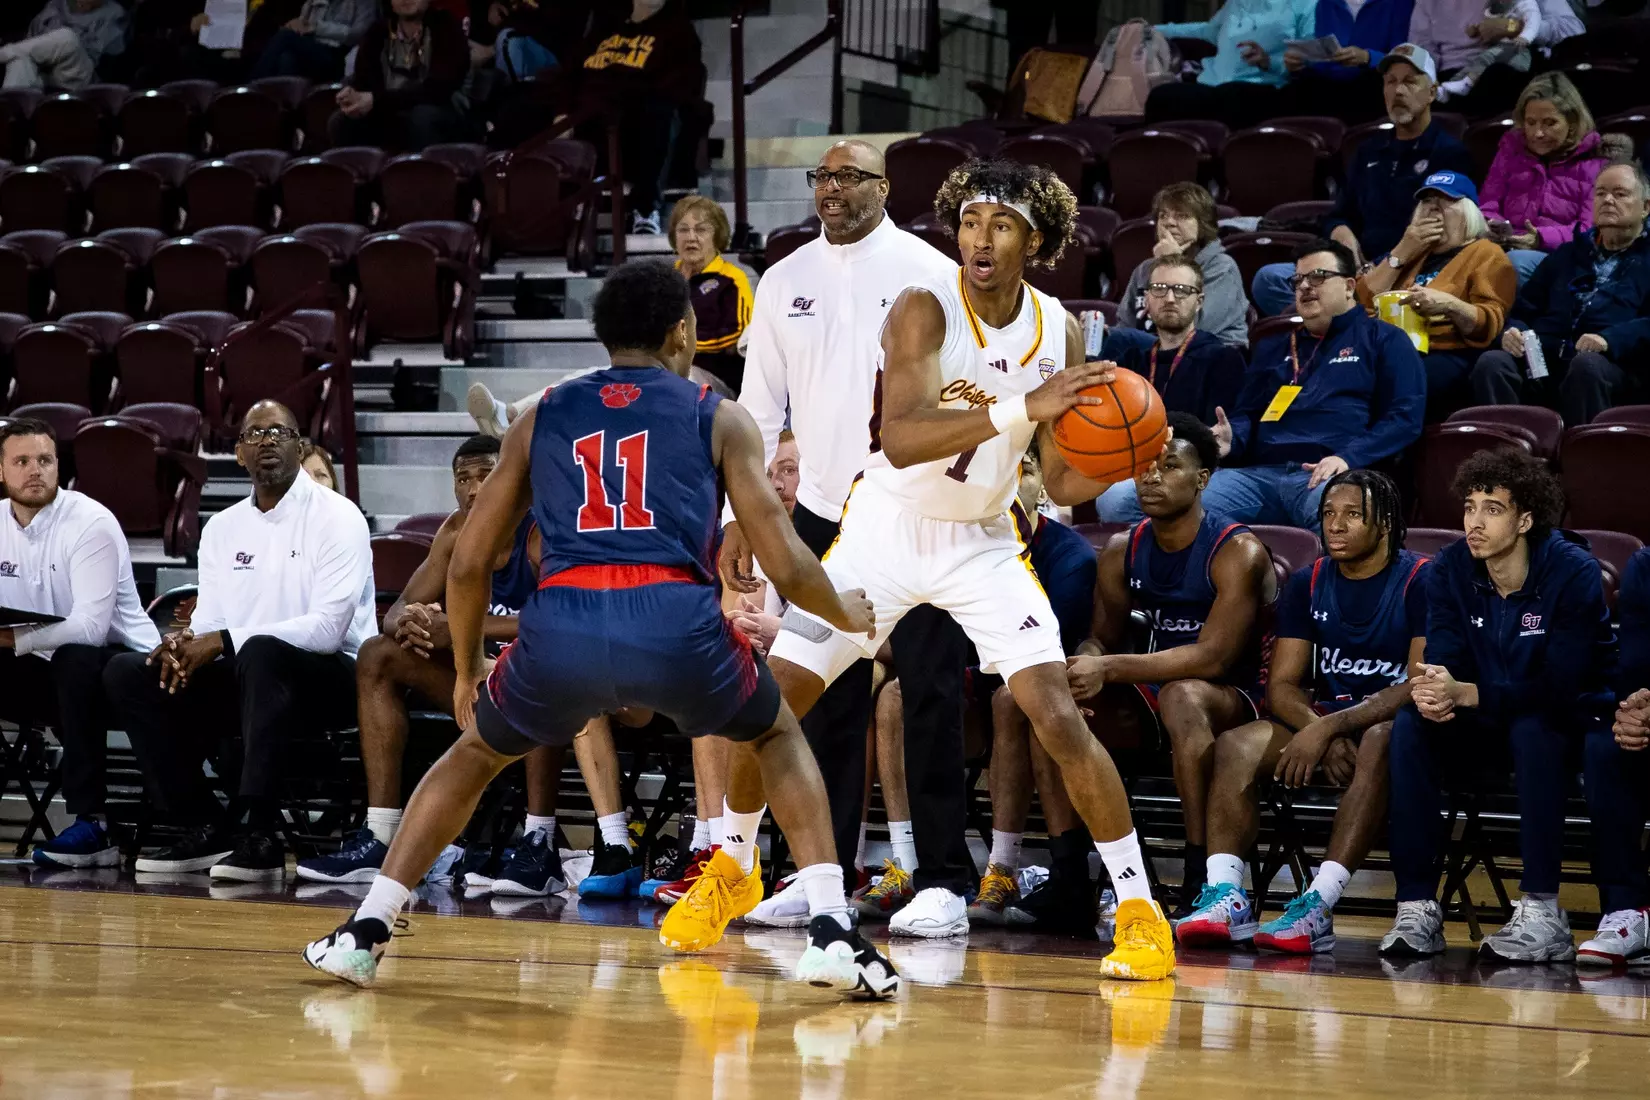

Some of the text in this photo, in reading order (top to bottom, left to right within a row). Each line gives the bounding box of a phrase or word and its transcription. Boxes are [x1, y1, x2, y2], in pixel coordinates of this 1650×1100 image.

[791, 296, 816, 311] CU
[573, 430, 657, 532] 11
[235, 551, 255, 564] CU
[1521, 612, 1542, 630] CU
